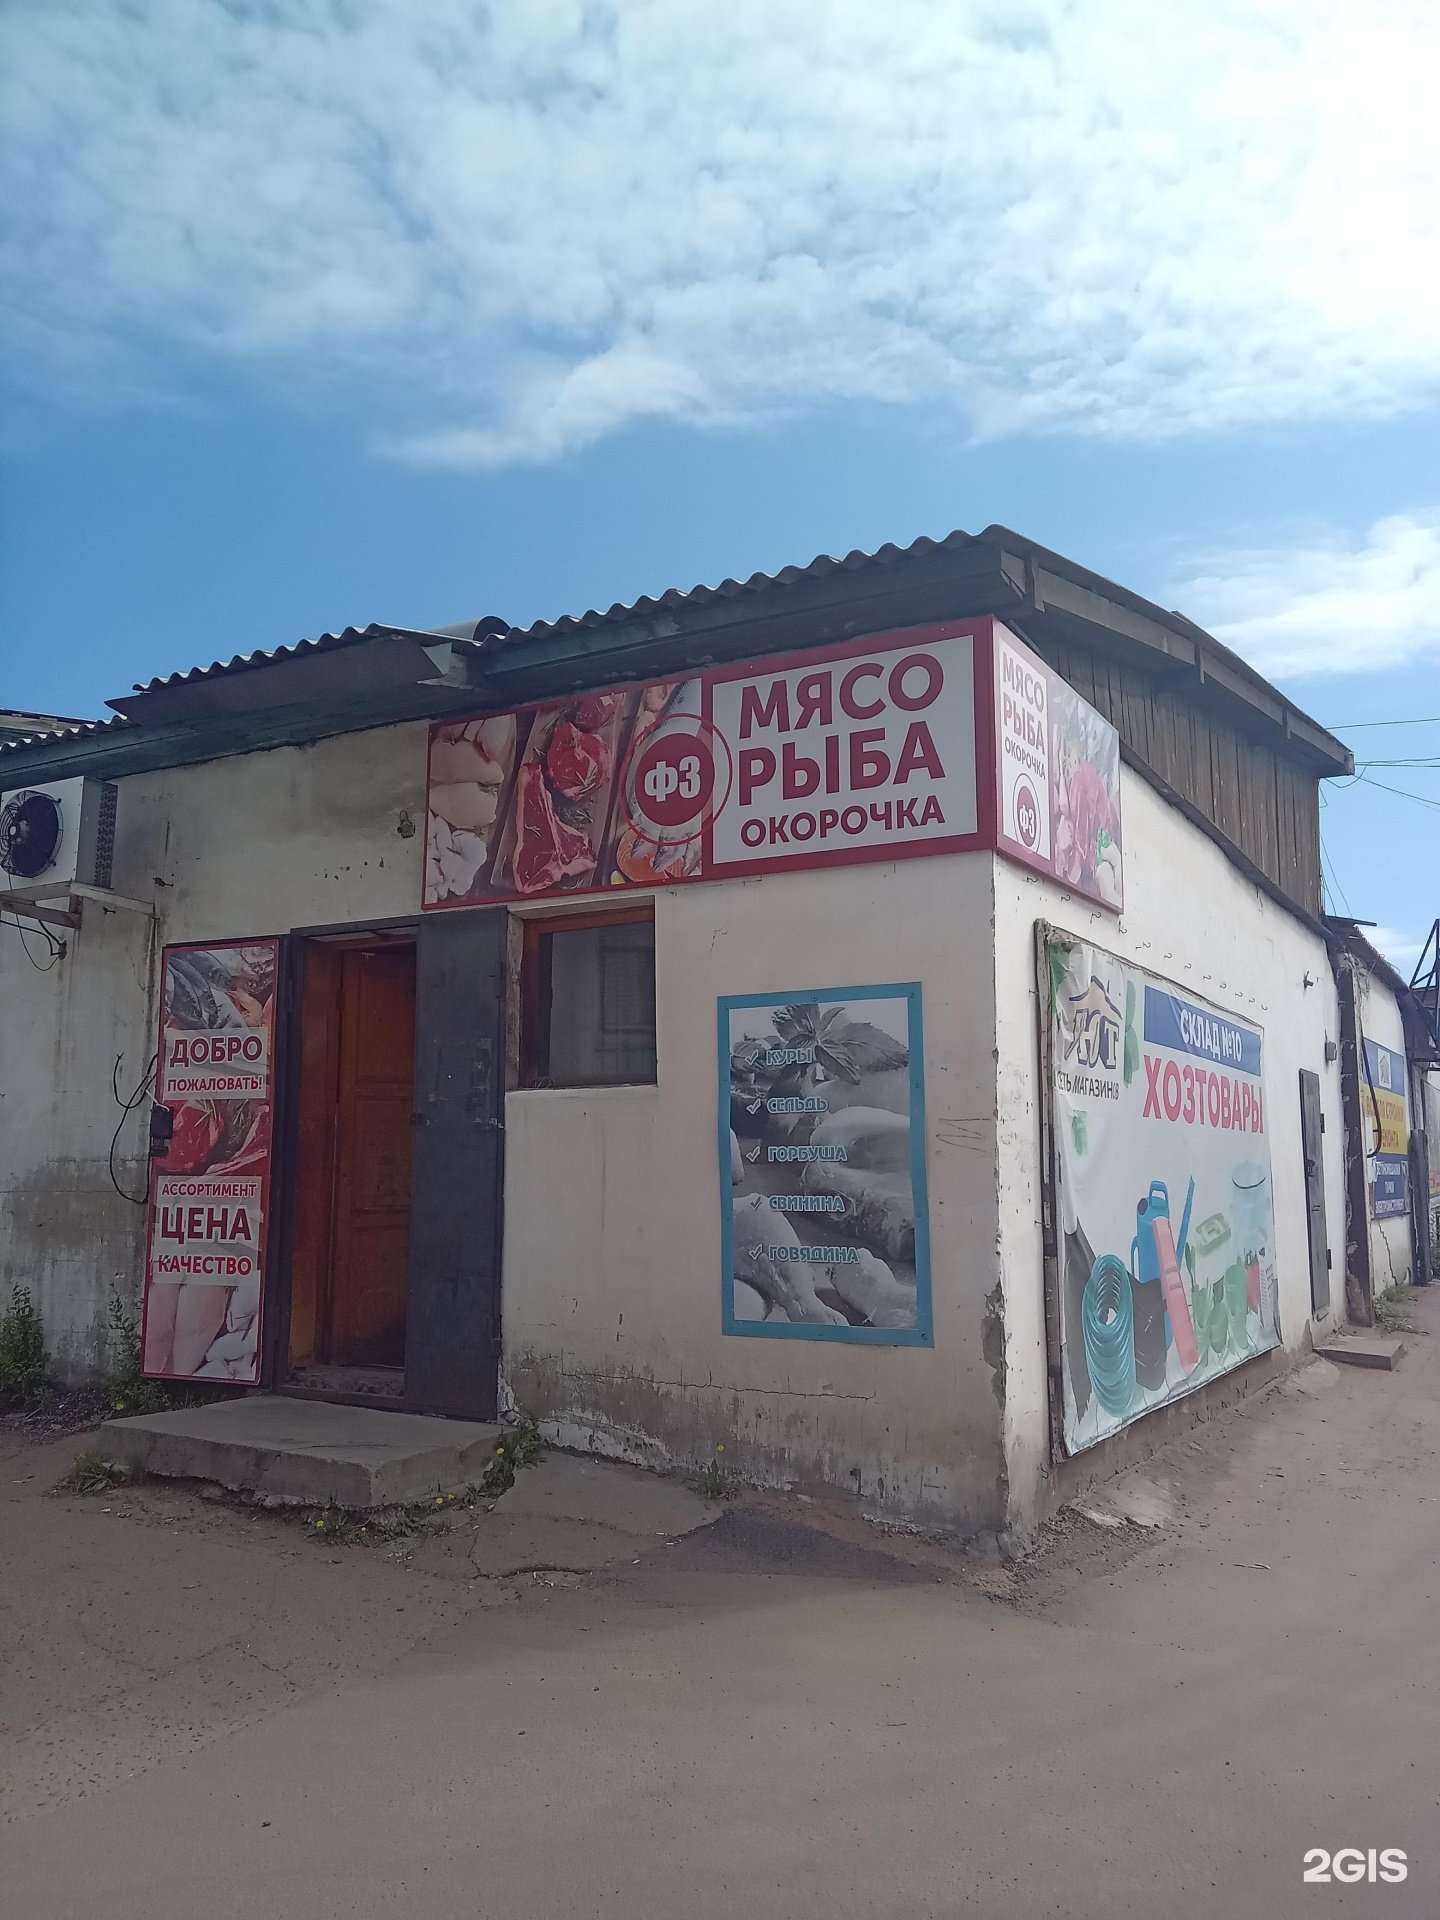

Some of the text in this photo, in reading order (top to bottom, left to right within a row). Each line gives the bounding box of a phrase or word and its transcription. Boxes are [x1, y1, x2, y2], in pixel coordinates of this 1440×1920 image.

[740, 652, 944, 739] МЯСО
[1002, 651, 1044, 713] МЯСО
[1003, 698, 1046, 756] РЫБА
[738, 721, 946, 806] РЫБА
[1004, 737, 1046, 779] ОКОРОЧКА
[740, 795, 945, 847] ОКОРОЧКА
[169, 1035, 263, 1068] ДОБРО
[1180, 1008, 1242, 1062] СКЛАД №10
[766, 1048, 812, 1065] КУРЫ
[167, 1077, 262, 1092] ПОЖАЛОВАТЬ!
[1072, 1074, 1120, 1101] МАГАЗИНОВ
[1143, 1054, 1264, 1134] ХОЗТОВАРЫ
[767, 1097, 829, 1113] СЕЛЬДЬ
[768, 1146, 848, 1162] ГОРБУША
[162, 1183, 257, 1197] АССОРТИМЕНТ
[768, 1195, 846, 1212] СВИНИНА
[161, 1206, 252, 1244] ЦЕНА
[158, 1254, 253, 1276] КАЧЕСТВО
[768, 1246, 860, 1264] ГОВЯДИНА
